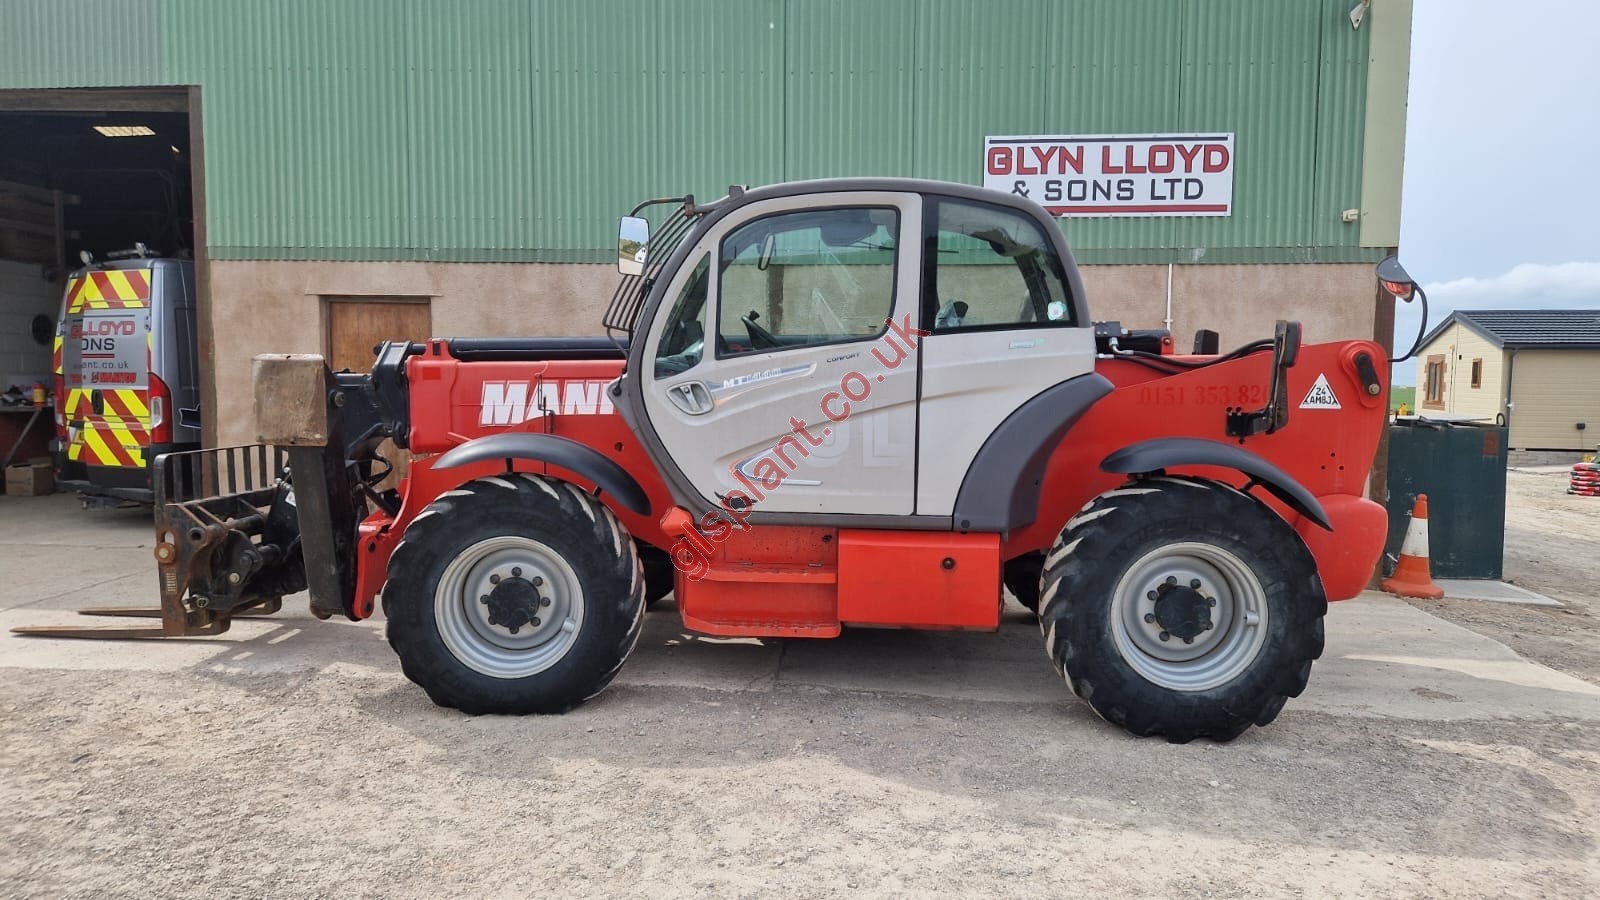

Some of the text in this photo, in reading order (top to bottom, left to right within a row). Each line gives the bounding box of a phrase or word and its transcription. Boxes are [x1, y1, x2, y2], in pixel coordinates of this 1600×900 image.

[987, 144, 1230, 175] GLYN LLOYD
[1011, 178, 1205, 201] & SONS LTD
[1195, 385, 1230, 405] 353
[1315, 386, 1327, 396] 24
